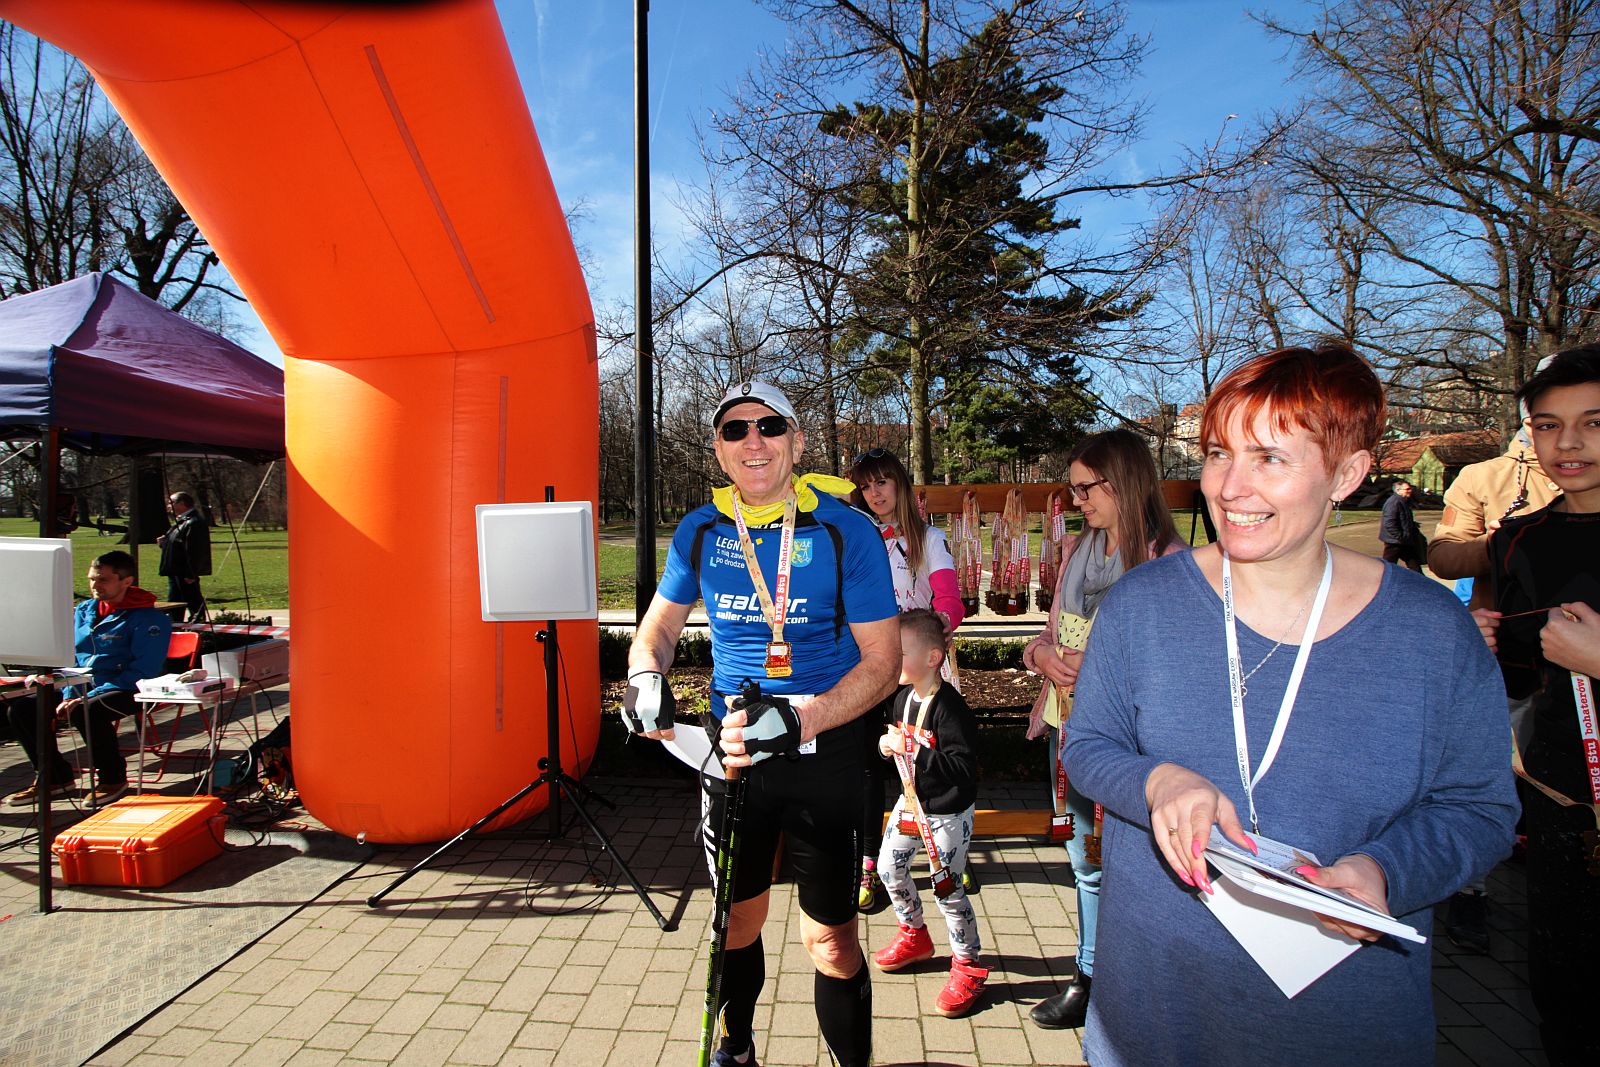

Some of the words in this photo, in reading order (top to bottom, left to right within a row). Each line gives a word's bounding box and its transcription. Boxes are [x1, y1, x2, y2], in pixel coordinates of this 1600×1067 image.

[779, 529, 790, 572] bohaterów
[724, 558, 745, 569] drodze
[778, 576, 786, 594] Stu
[775, 596, 785, 622] BIEG
[1576, 678, 1593, 735] bohaterów
[1588, 741, 1598, 764] Stu
